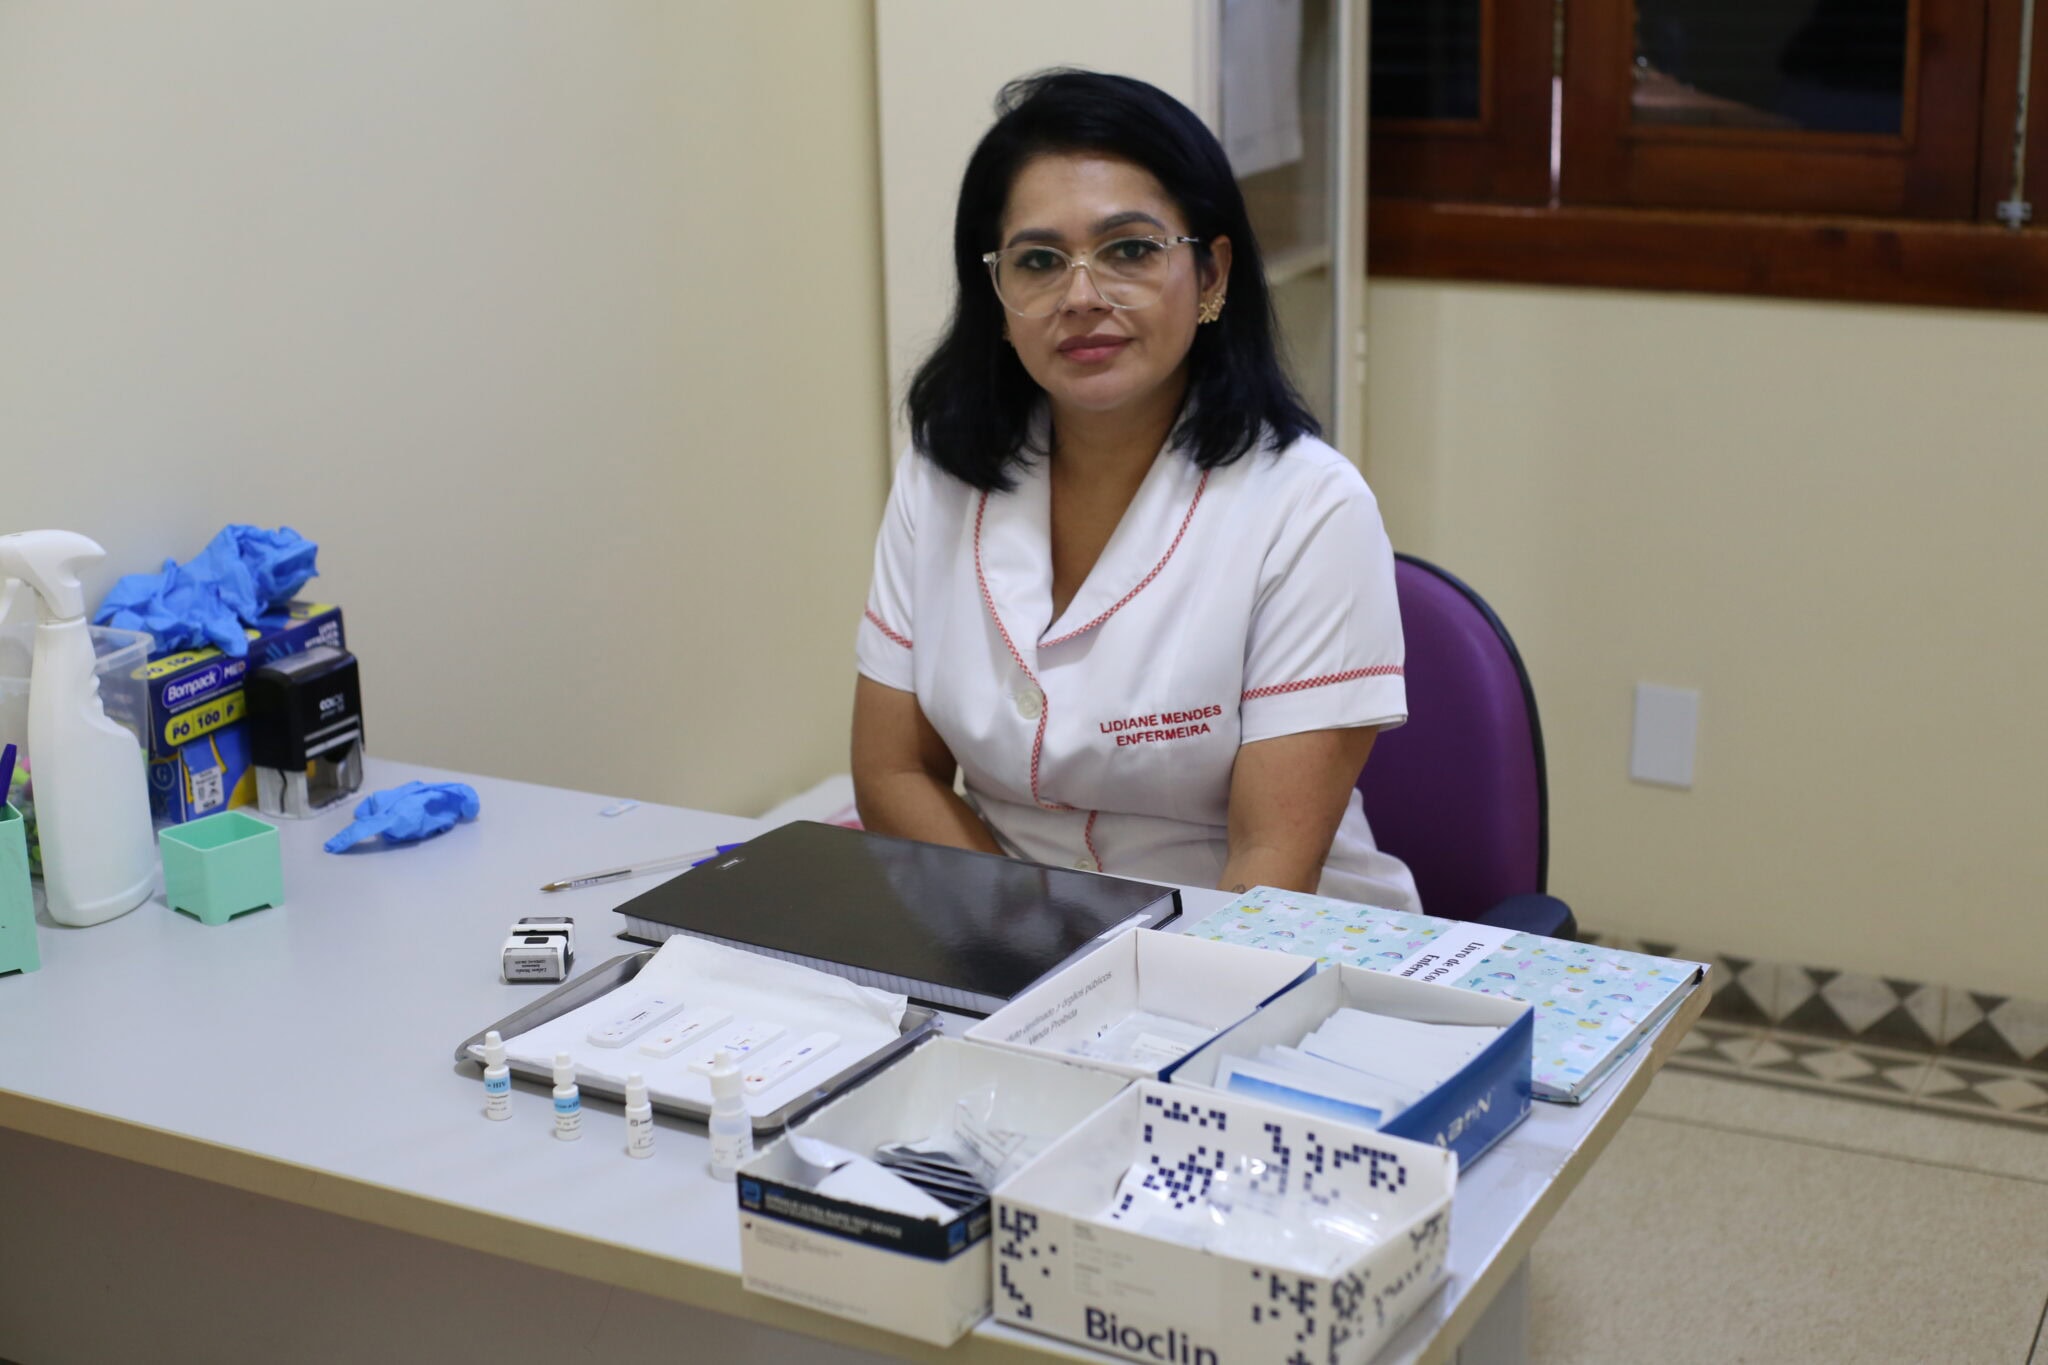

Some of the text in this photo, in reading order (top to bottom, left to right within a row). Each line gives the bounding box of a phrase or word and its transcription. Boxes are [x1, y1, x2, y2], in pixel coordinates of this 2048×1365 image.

[167, 669, 218, 702] Bompack
[197, 710, 220, 729] 100
[226, 703, 235, 717] P
[1100, 704, 1223, 734] LIDIANE MENDES
[1115, 722, 1211, 747] ENFERMEIRA
[1442, 957, 1461, 968] de
[1455, 941, 1485, 959] Livro
[1085, 1305, 1218, 1365] Bioclin
